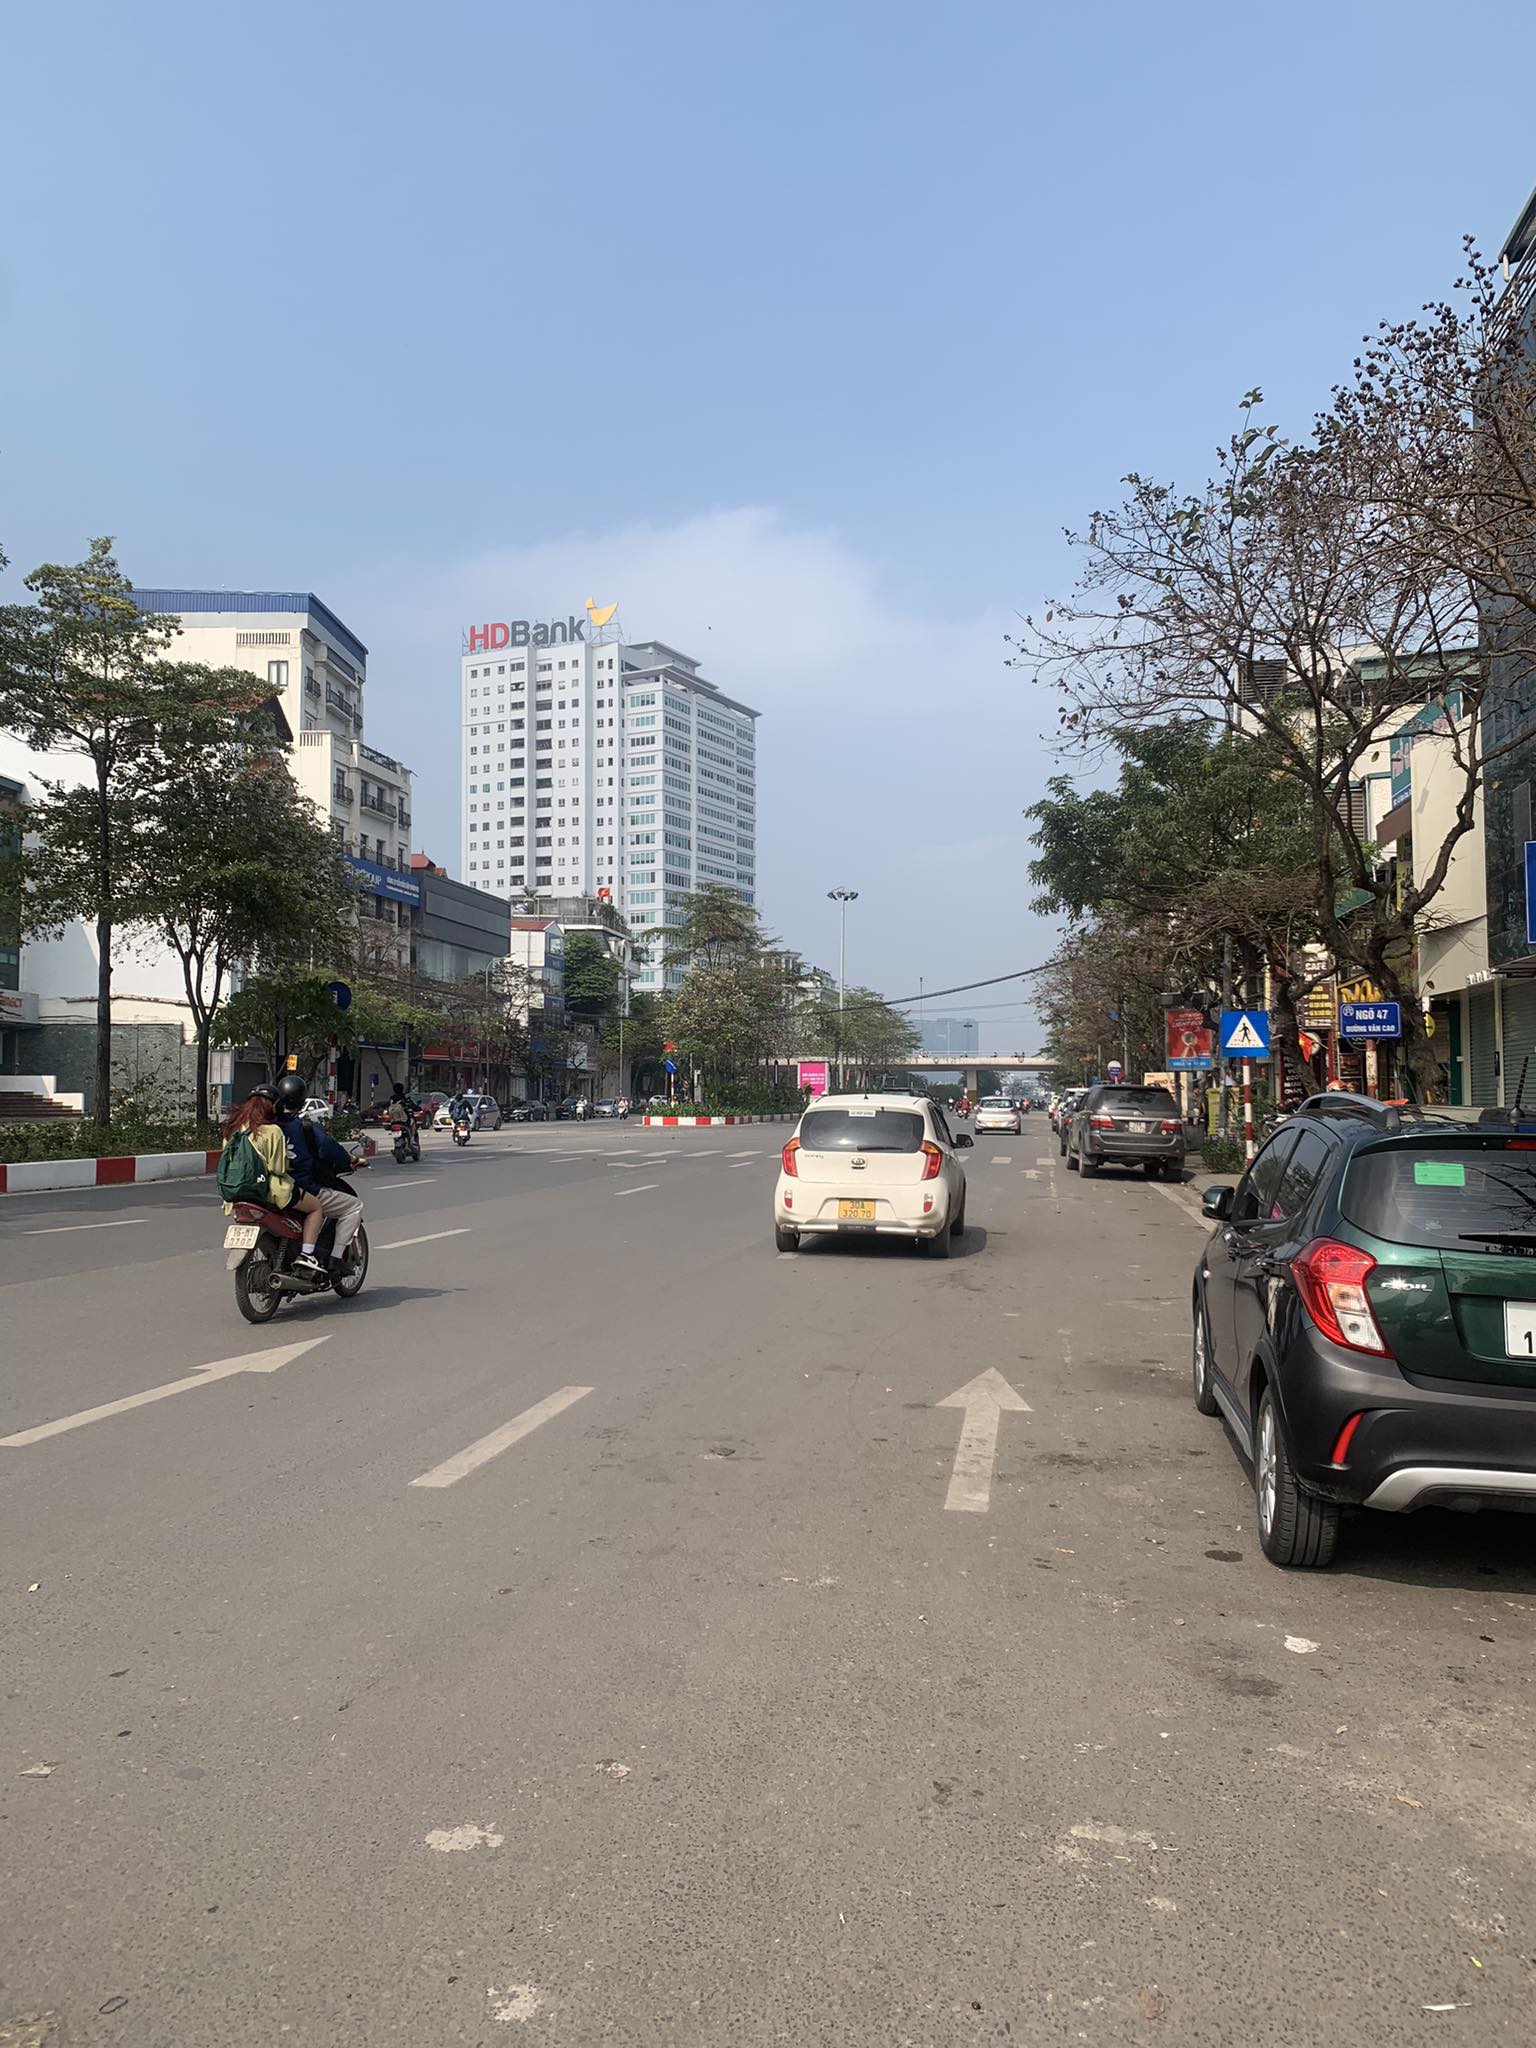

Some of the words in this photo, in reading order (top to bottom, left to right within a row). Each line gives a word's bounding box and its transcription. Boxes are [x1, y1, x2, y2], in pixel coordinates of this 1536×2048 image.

[469, 616, 586, 651] HDBank
[1355, 1007, 1375, 1020] NGÕ
[1376, 1009, 1388, 1020] 47
[1368, 1024, 1381, 1032] VĂN
[1382, 1024, 1396, 1032] CAO
[849, 1200, 865, 1209] 30A
